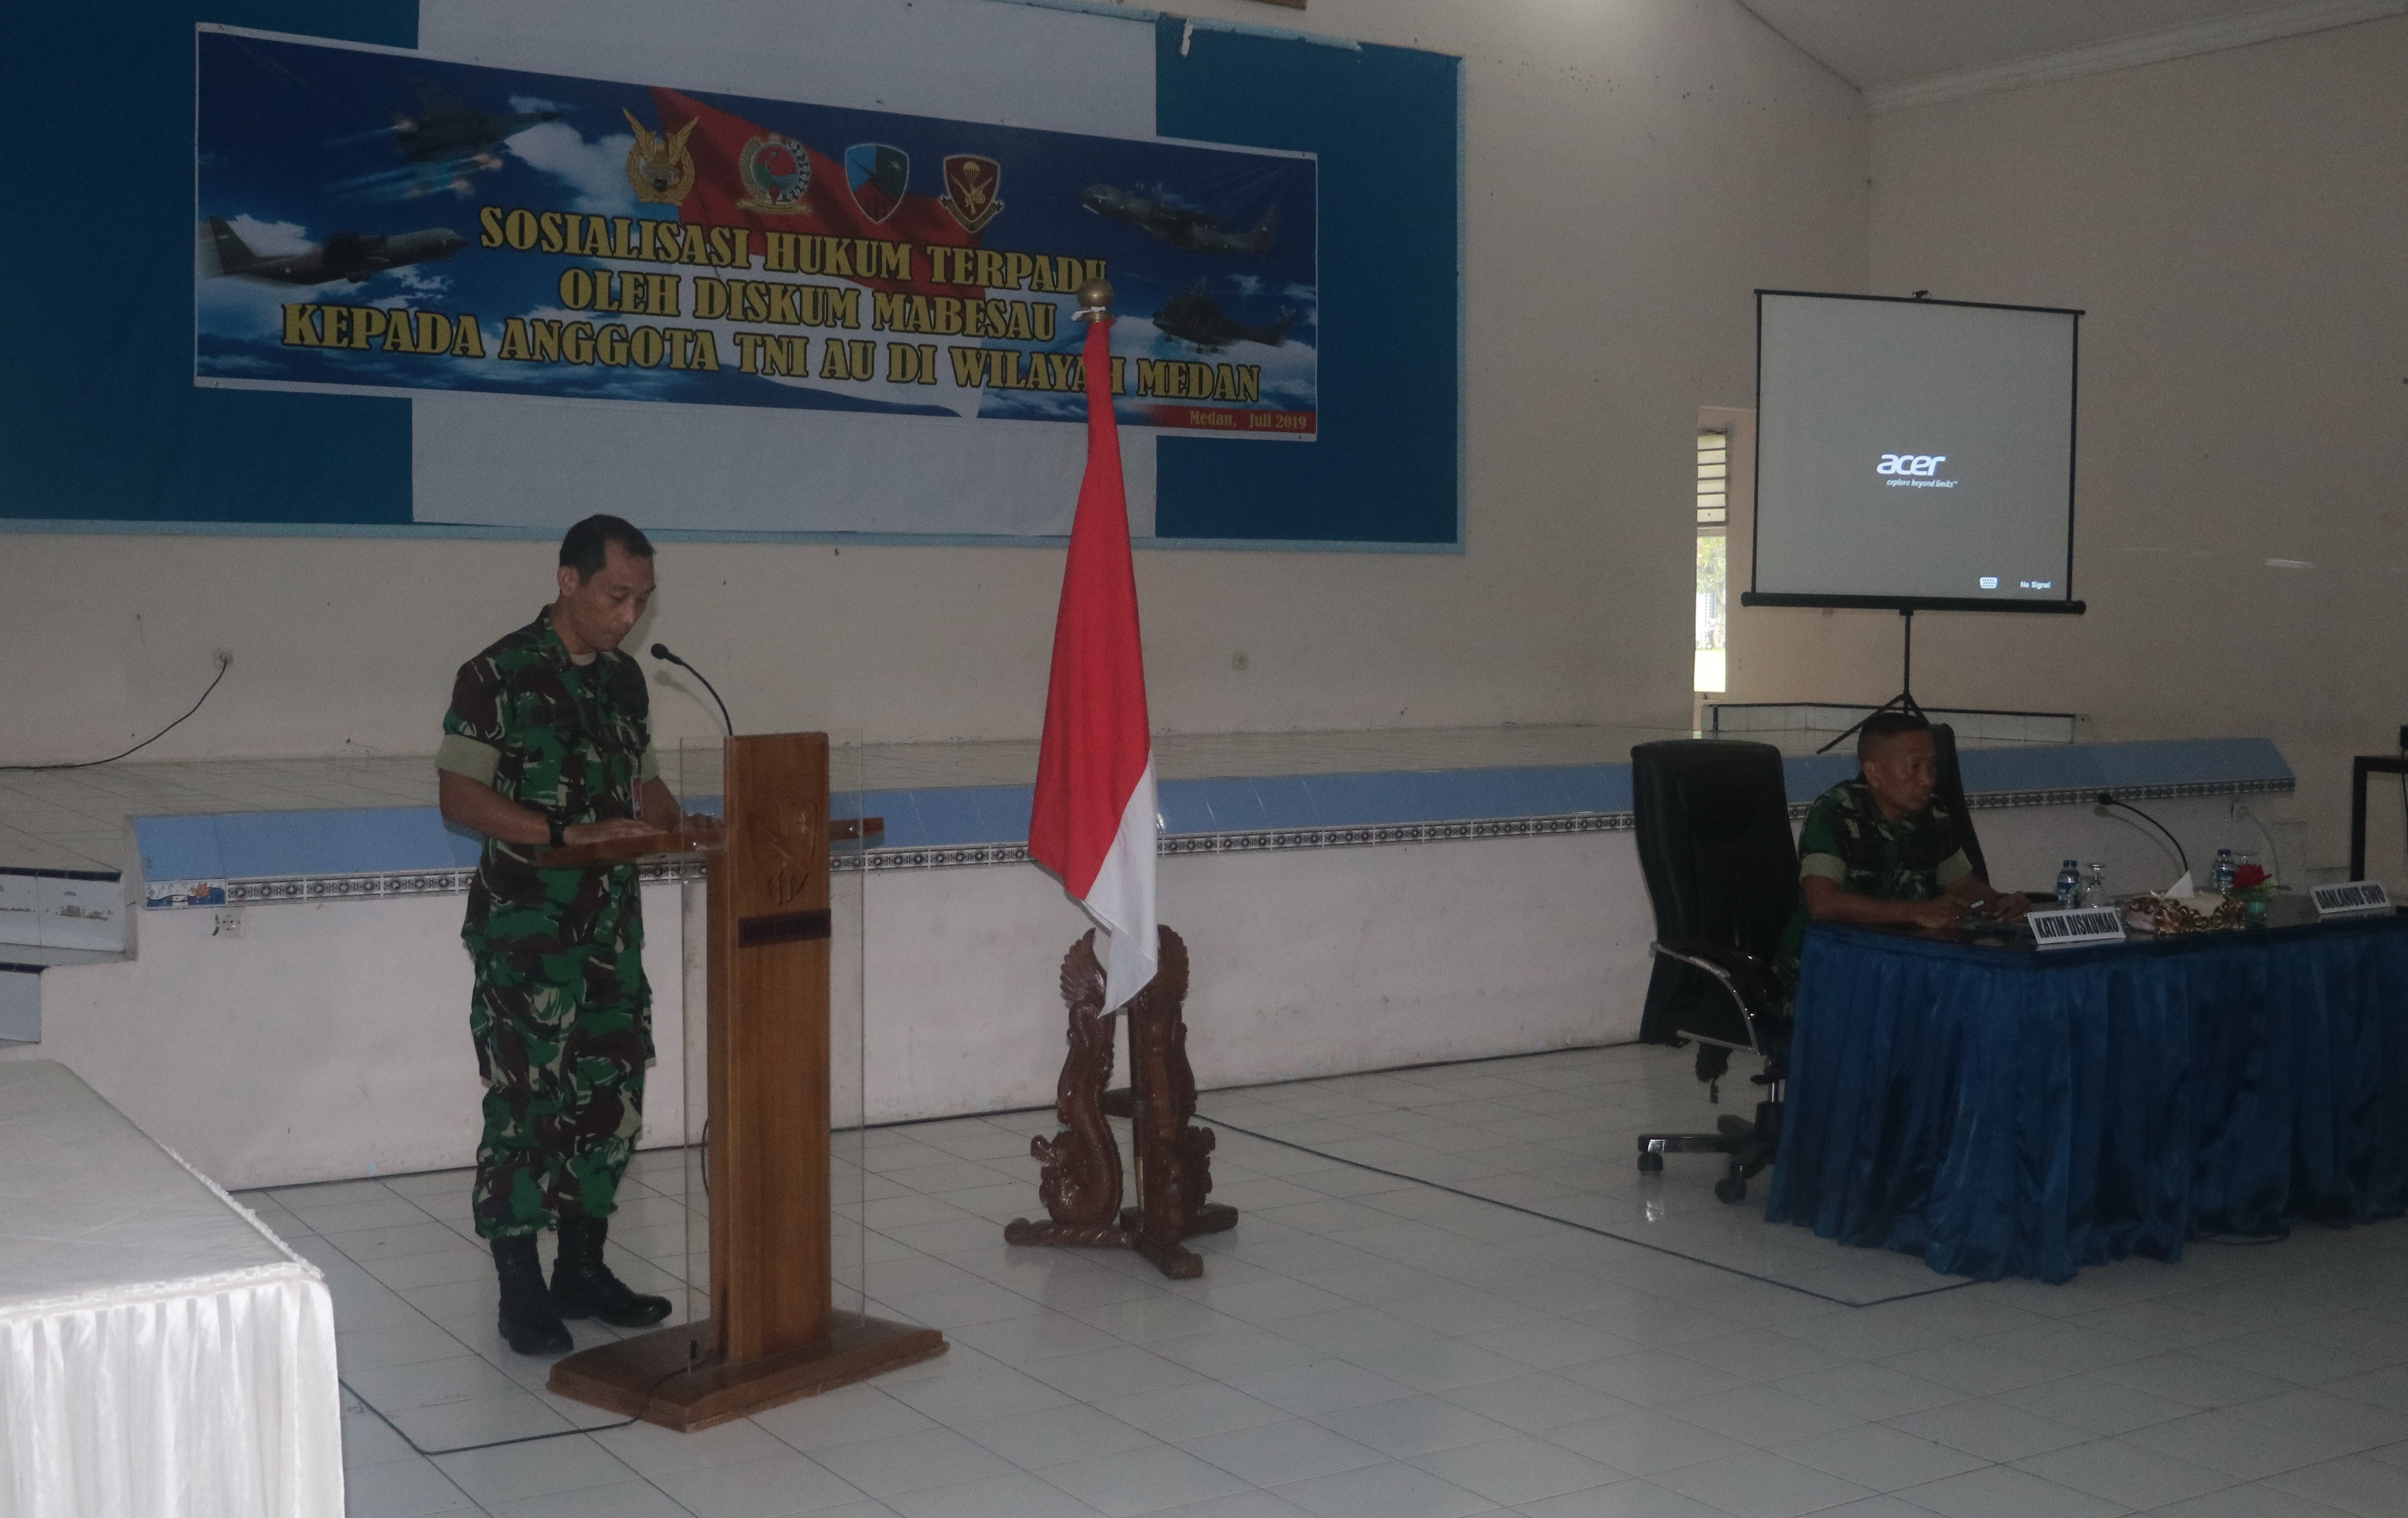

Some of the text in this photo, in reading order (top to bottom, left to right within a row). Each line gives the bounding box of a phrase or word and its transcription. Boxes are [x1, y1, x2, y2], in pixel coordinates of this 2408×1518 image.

[480, 207, 749, 268] SOSIALISASI
[765, 232, 912, 282] HUKUM
[560, 269, 1057, 342] OLEH DISKUM MABESAU
[282, 303, 485, 357] KEPADA
[500, 319, 720, 372] ANGGOTA
[735, 333, 808, 379] TNI
[821, 338, 875, 383] AU
[887, 342, 937, 386] DI
[1137, 357, 1259, 402] MEDAN
[1190, 410, 1306, 429] Medan, Juli 2019
[1877, 454, 1946, 476] acer
[1887, 478, 1909, 488] explore
[1911, 478, 1935, 488] beyond
[2031, 581, 2051, 589] Signal
[2361, 884, 2385, 904] SWO
[2035, 912, 2119, 939] KATIM DISKUMAU
